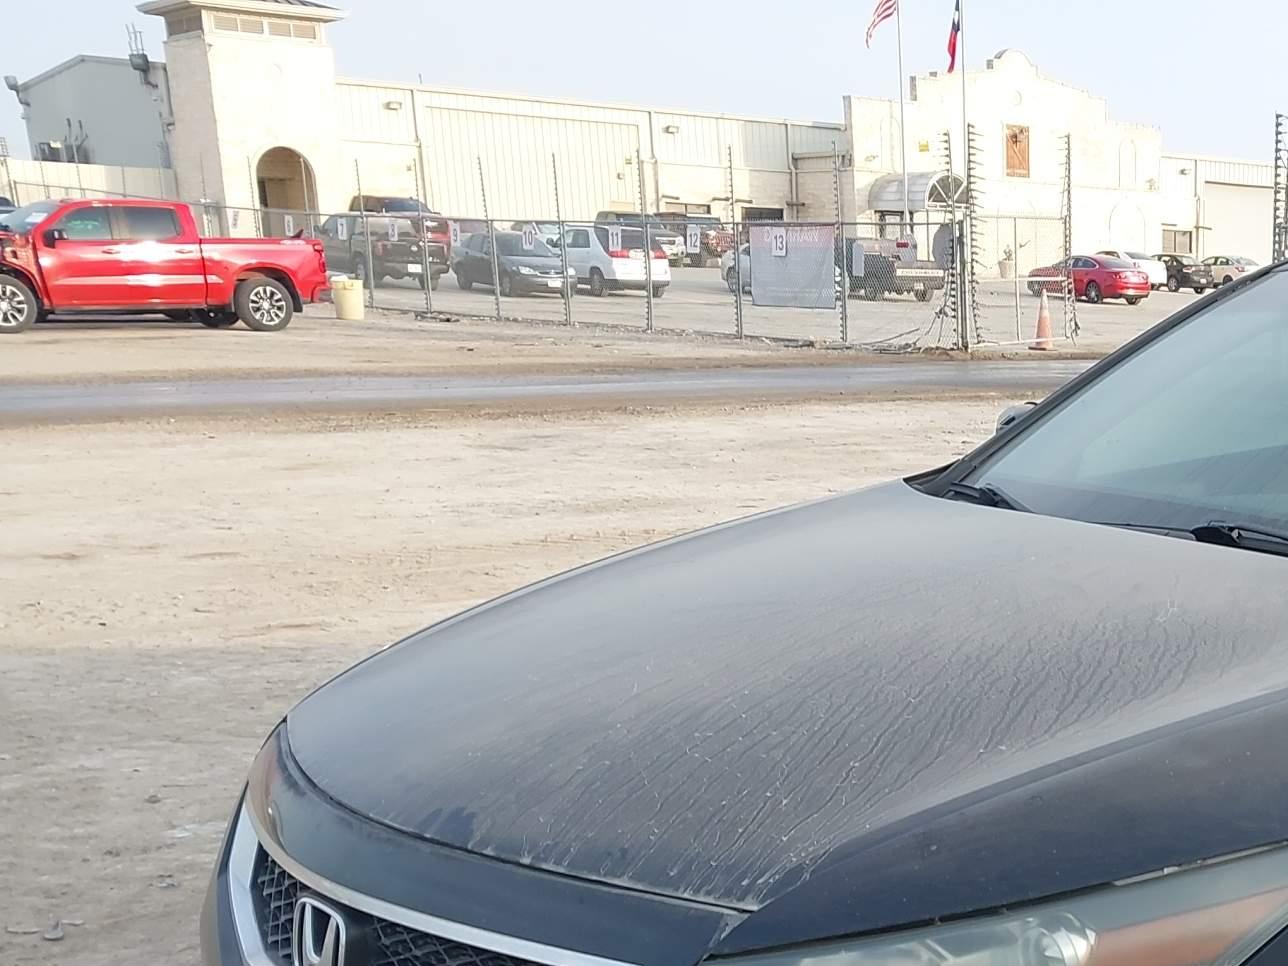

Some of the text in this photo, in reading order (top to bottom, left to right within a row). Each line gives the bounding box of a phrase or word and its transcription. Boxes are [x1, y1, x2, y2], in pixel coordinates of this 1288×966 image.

[452, 228, 459, 242] 9
[523, 230, 533, 246] 10
[610, 231, 619, 246] 11
[688, 232, 698, 248] 12
[773, 234, 785, 251] 13
